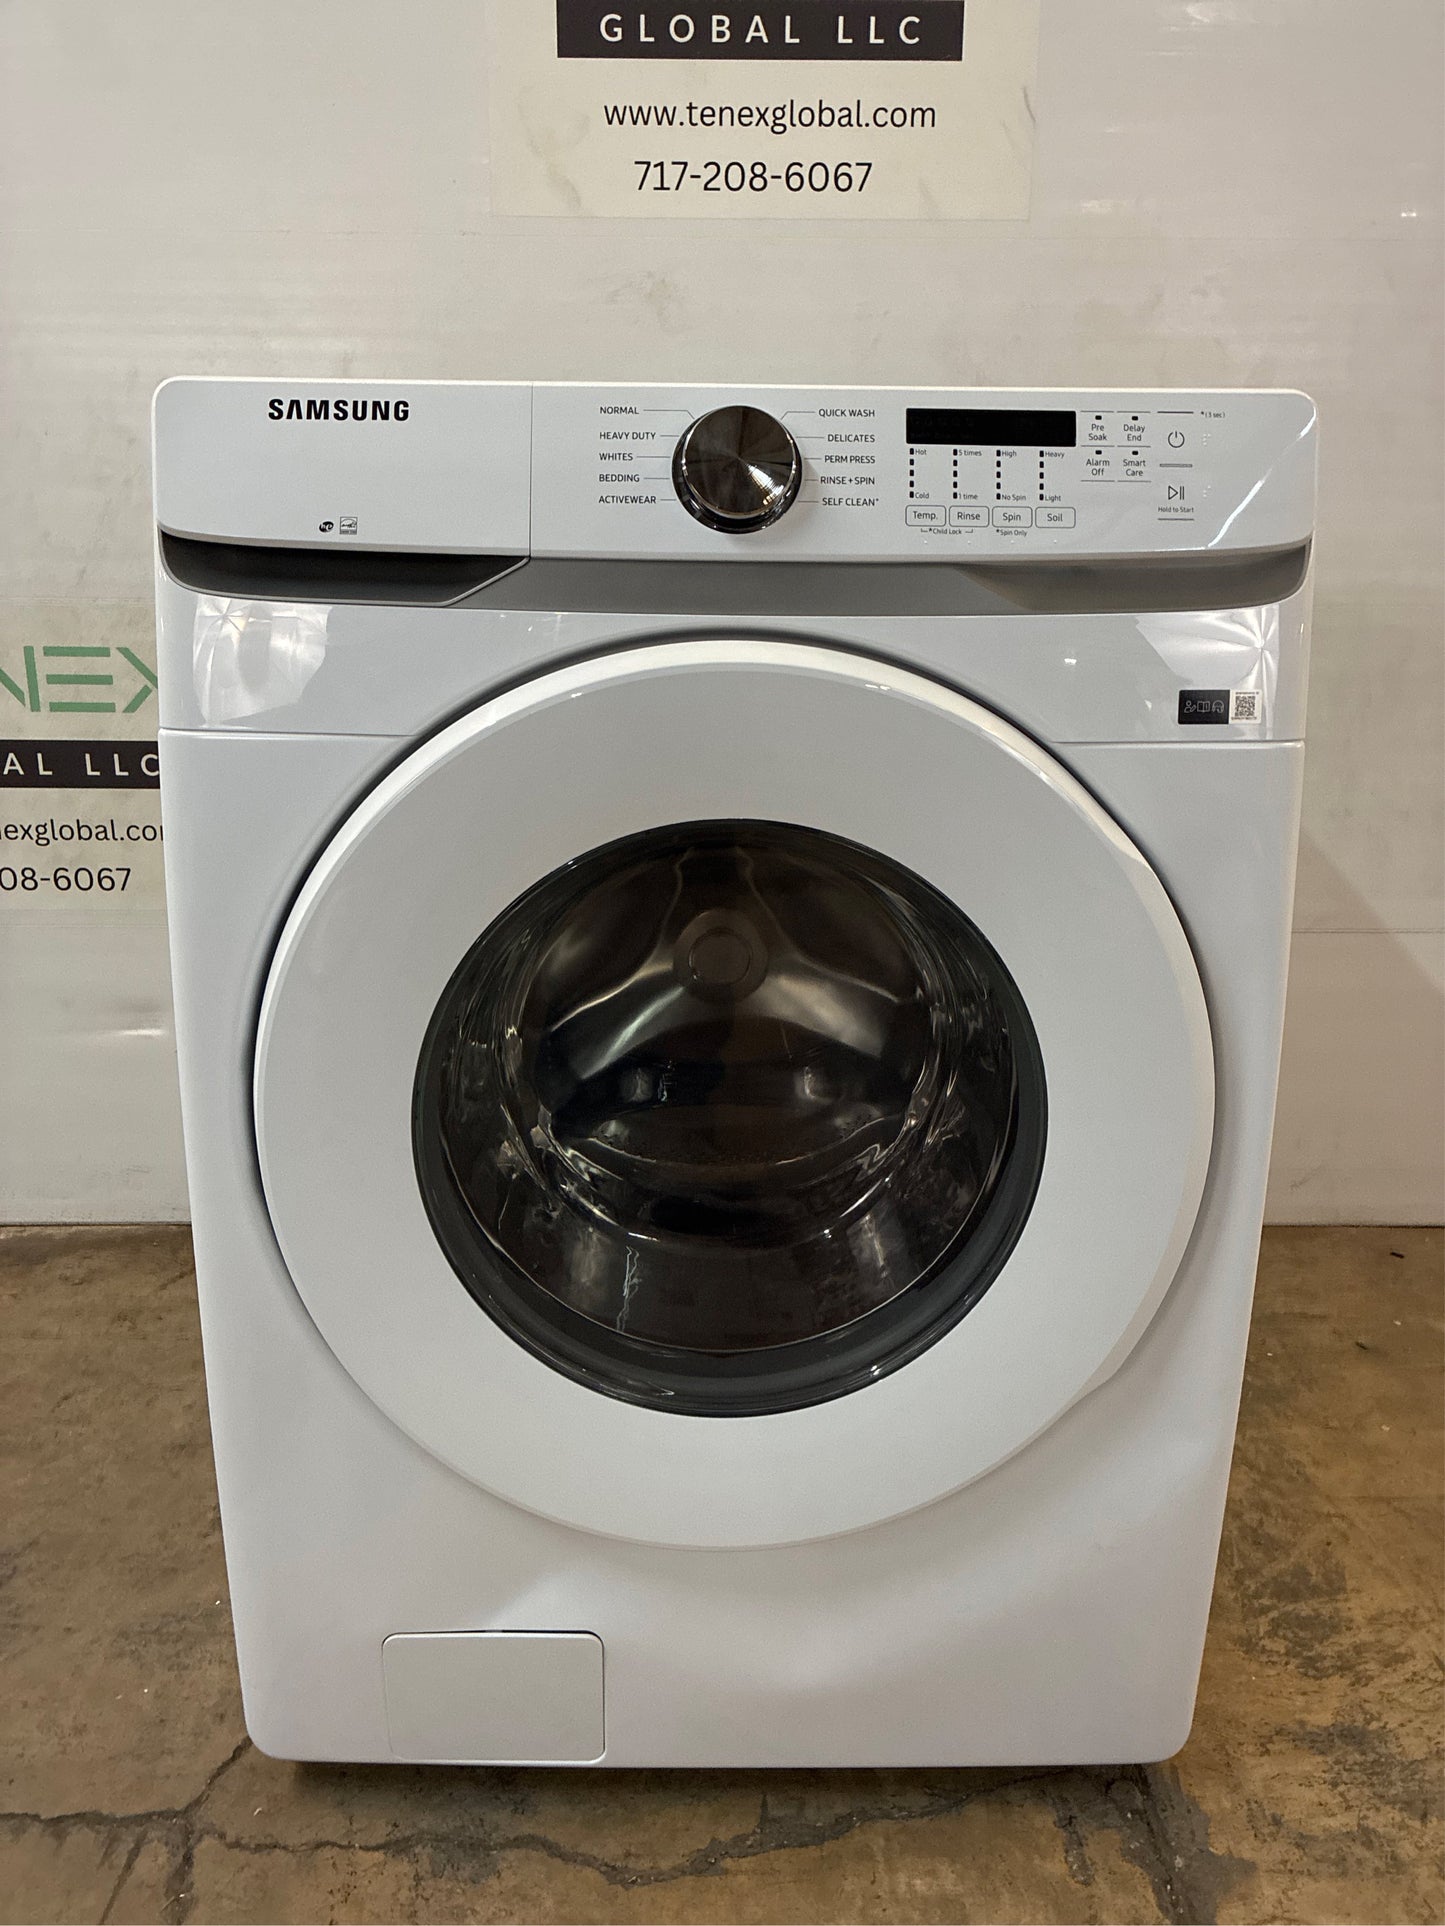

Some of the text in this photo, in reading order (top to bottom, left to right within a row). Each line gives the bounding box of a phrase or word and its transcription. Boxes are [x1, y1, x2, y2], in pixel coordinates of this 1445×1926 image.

[600, 14, 919, 44] GLOBAL LLC
[604, 99, 935, 134] www.tenexglobal.com
[635, 161, 872, 192] 717-208-6067
[269, 399, 409, 421] SAMSUNG
[600, 407, 640, 415] NORMAL
[819, 409, 875, 418] QUICK WASH
[1092, 424, 1105, 432] Pre
[1124, 424, 1146, 434] Delay
[600, 432, 656, 441] HEAVY DUTY
[828, 434, 876, 443] DELICATES
[1089, 433, 1108, 441] Soak
[1127, 434, 1142, 442] End
[599, 453, 634, 462] WHITES
[958, 449, 963, 457] 5
[1002, 450, 1017, 459] High
[825, 455, 876, 464] PERM PRESS
[1086, 459, 1110, 467] Alarm
[1123, 459, 1146, 467] Smart
[1092, 468, 1105, 476] Off
[1126, 469, 1144, 477] Care
[599, 474, 640, 483] BEDDING
[821, 476, 847, 485] RINSE
[855, 477, 875, 485] SPIN
[599, 496, 657, 504] ACTIVEWEAR
[915, 492, 930, 500] Cold
[1012, 494, 1027, 502] Spin
[1045, 495, 1062, 503] Light
[823, 497, 844, 506] SELF
[913, 511, 939, 522] Temp.
[958, 512, 981, 521] Rinse
[1003, 513, 1022, 523] Spin
[1047, 513, 1064, 522] Soil
[1014, 530, 1028, 538] Only
[3, 753, 159, 776] AL LLC
[0, 819, 163, 846] exglobal.co
[0, 867, 131, 891] 08-6067
